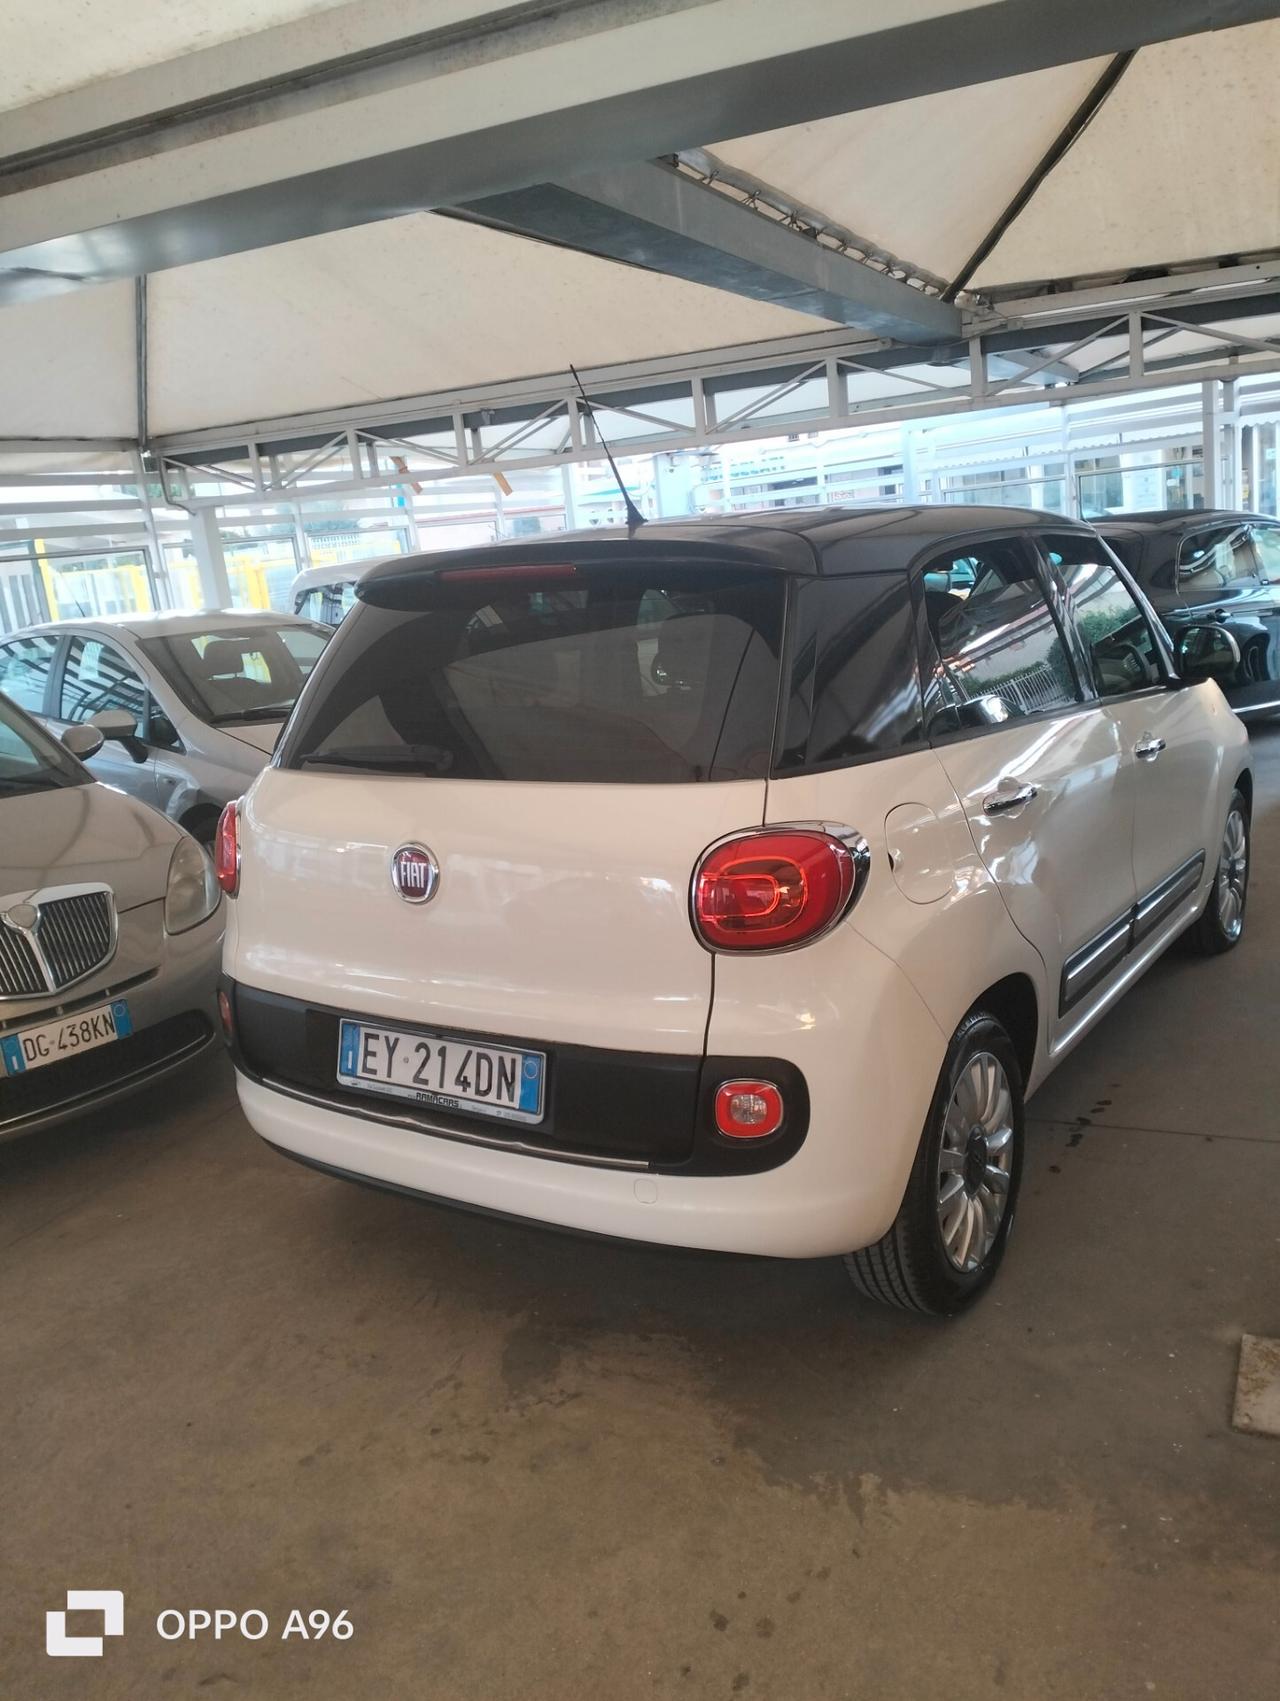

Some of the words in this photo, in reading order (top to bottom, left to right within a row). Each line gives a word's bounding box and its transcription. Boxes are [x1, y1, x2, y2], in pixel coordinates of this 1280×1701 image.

[400, 861, 427, 888] FIAT
[23, 1034, 49, 1062] DG
[58, 1011, 116, 1050] 438KN
[362, 1032, 400, 1078] EY
[412, 1041, 517, 1103] 214DN
